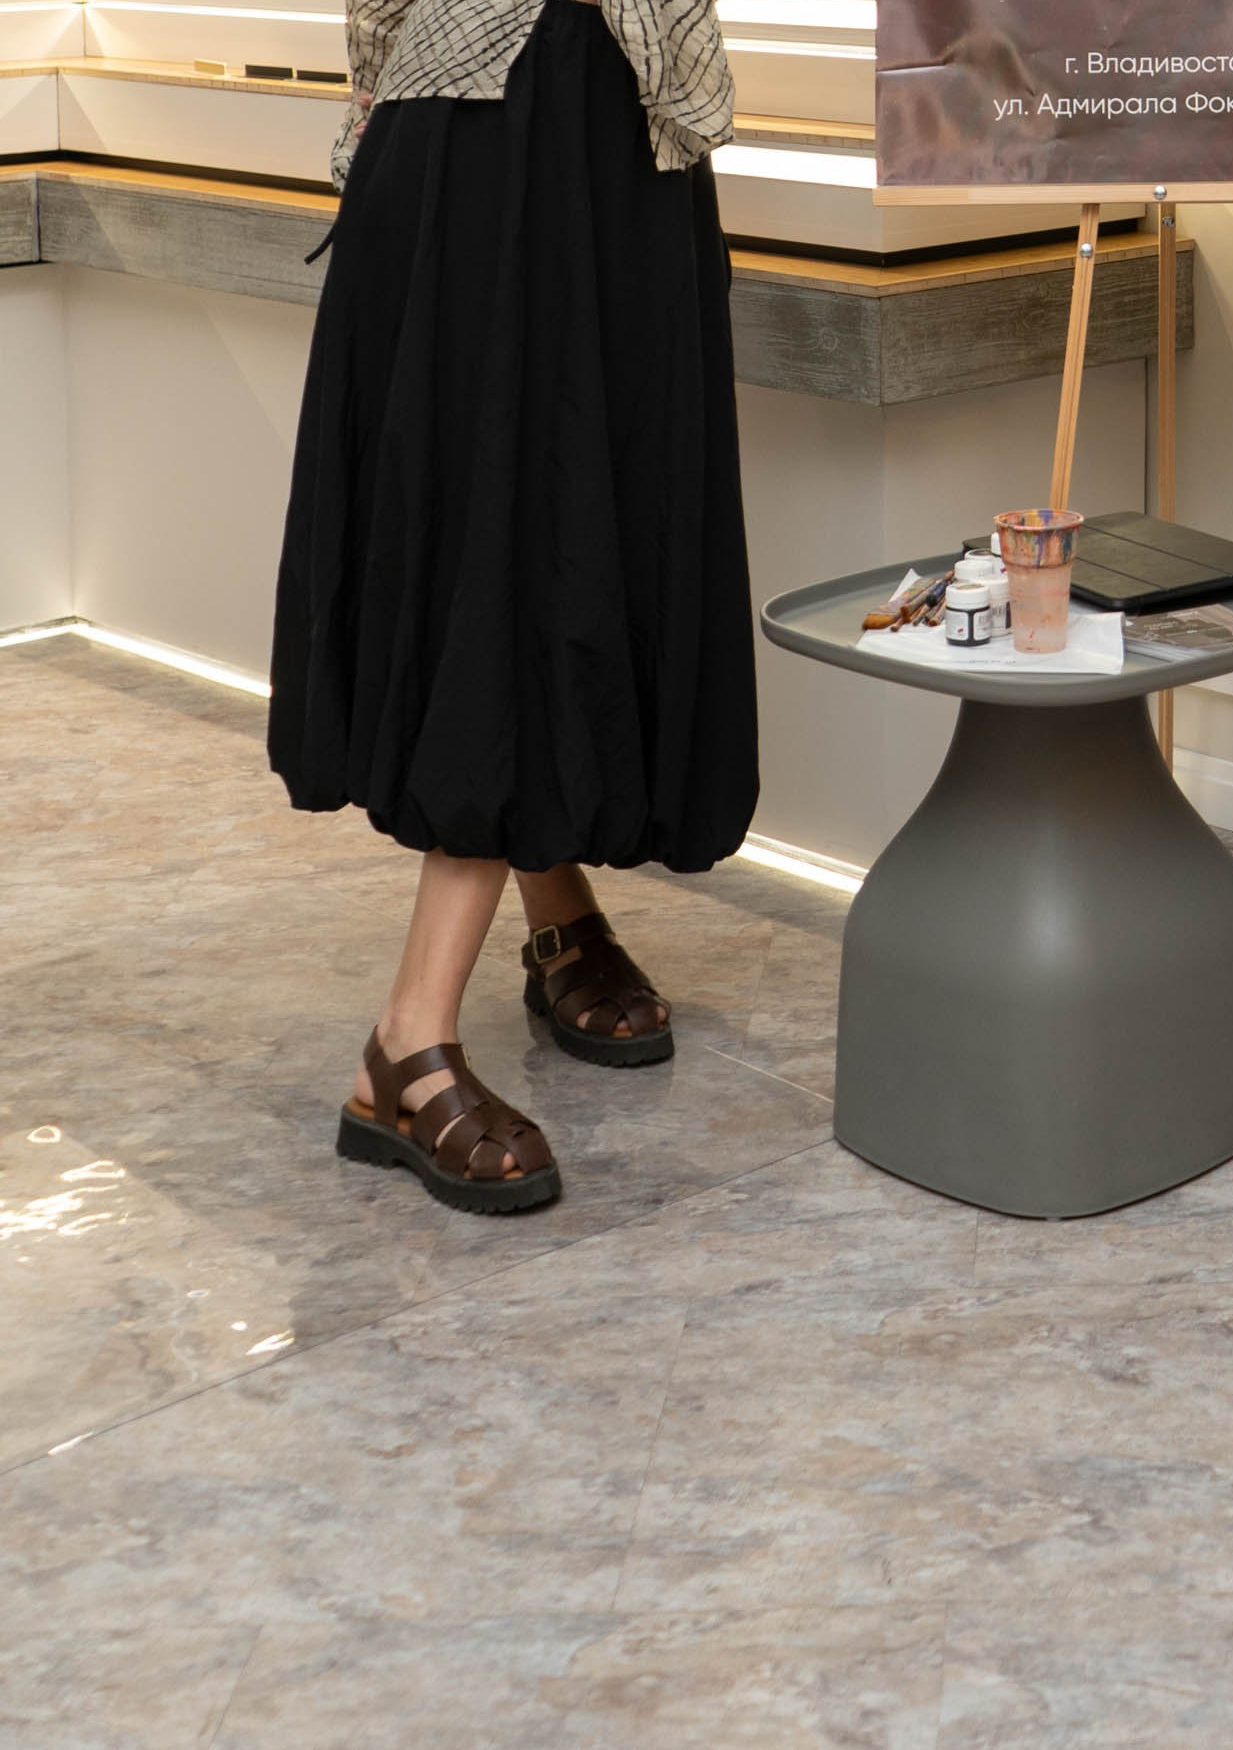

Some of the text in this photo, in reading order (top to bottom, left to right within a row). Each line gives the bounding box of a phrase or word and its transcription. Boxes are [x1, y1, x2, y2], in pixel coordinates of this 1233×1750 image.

[1064, 55, 1078, 74] г.
[993, 97, 1029, 121] ул.
[1037, 93, 1177, 119] Адмирала
